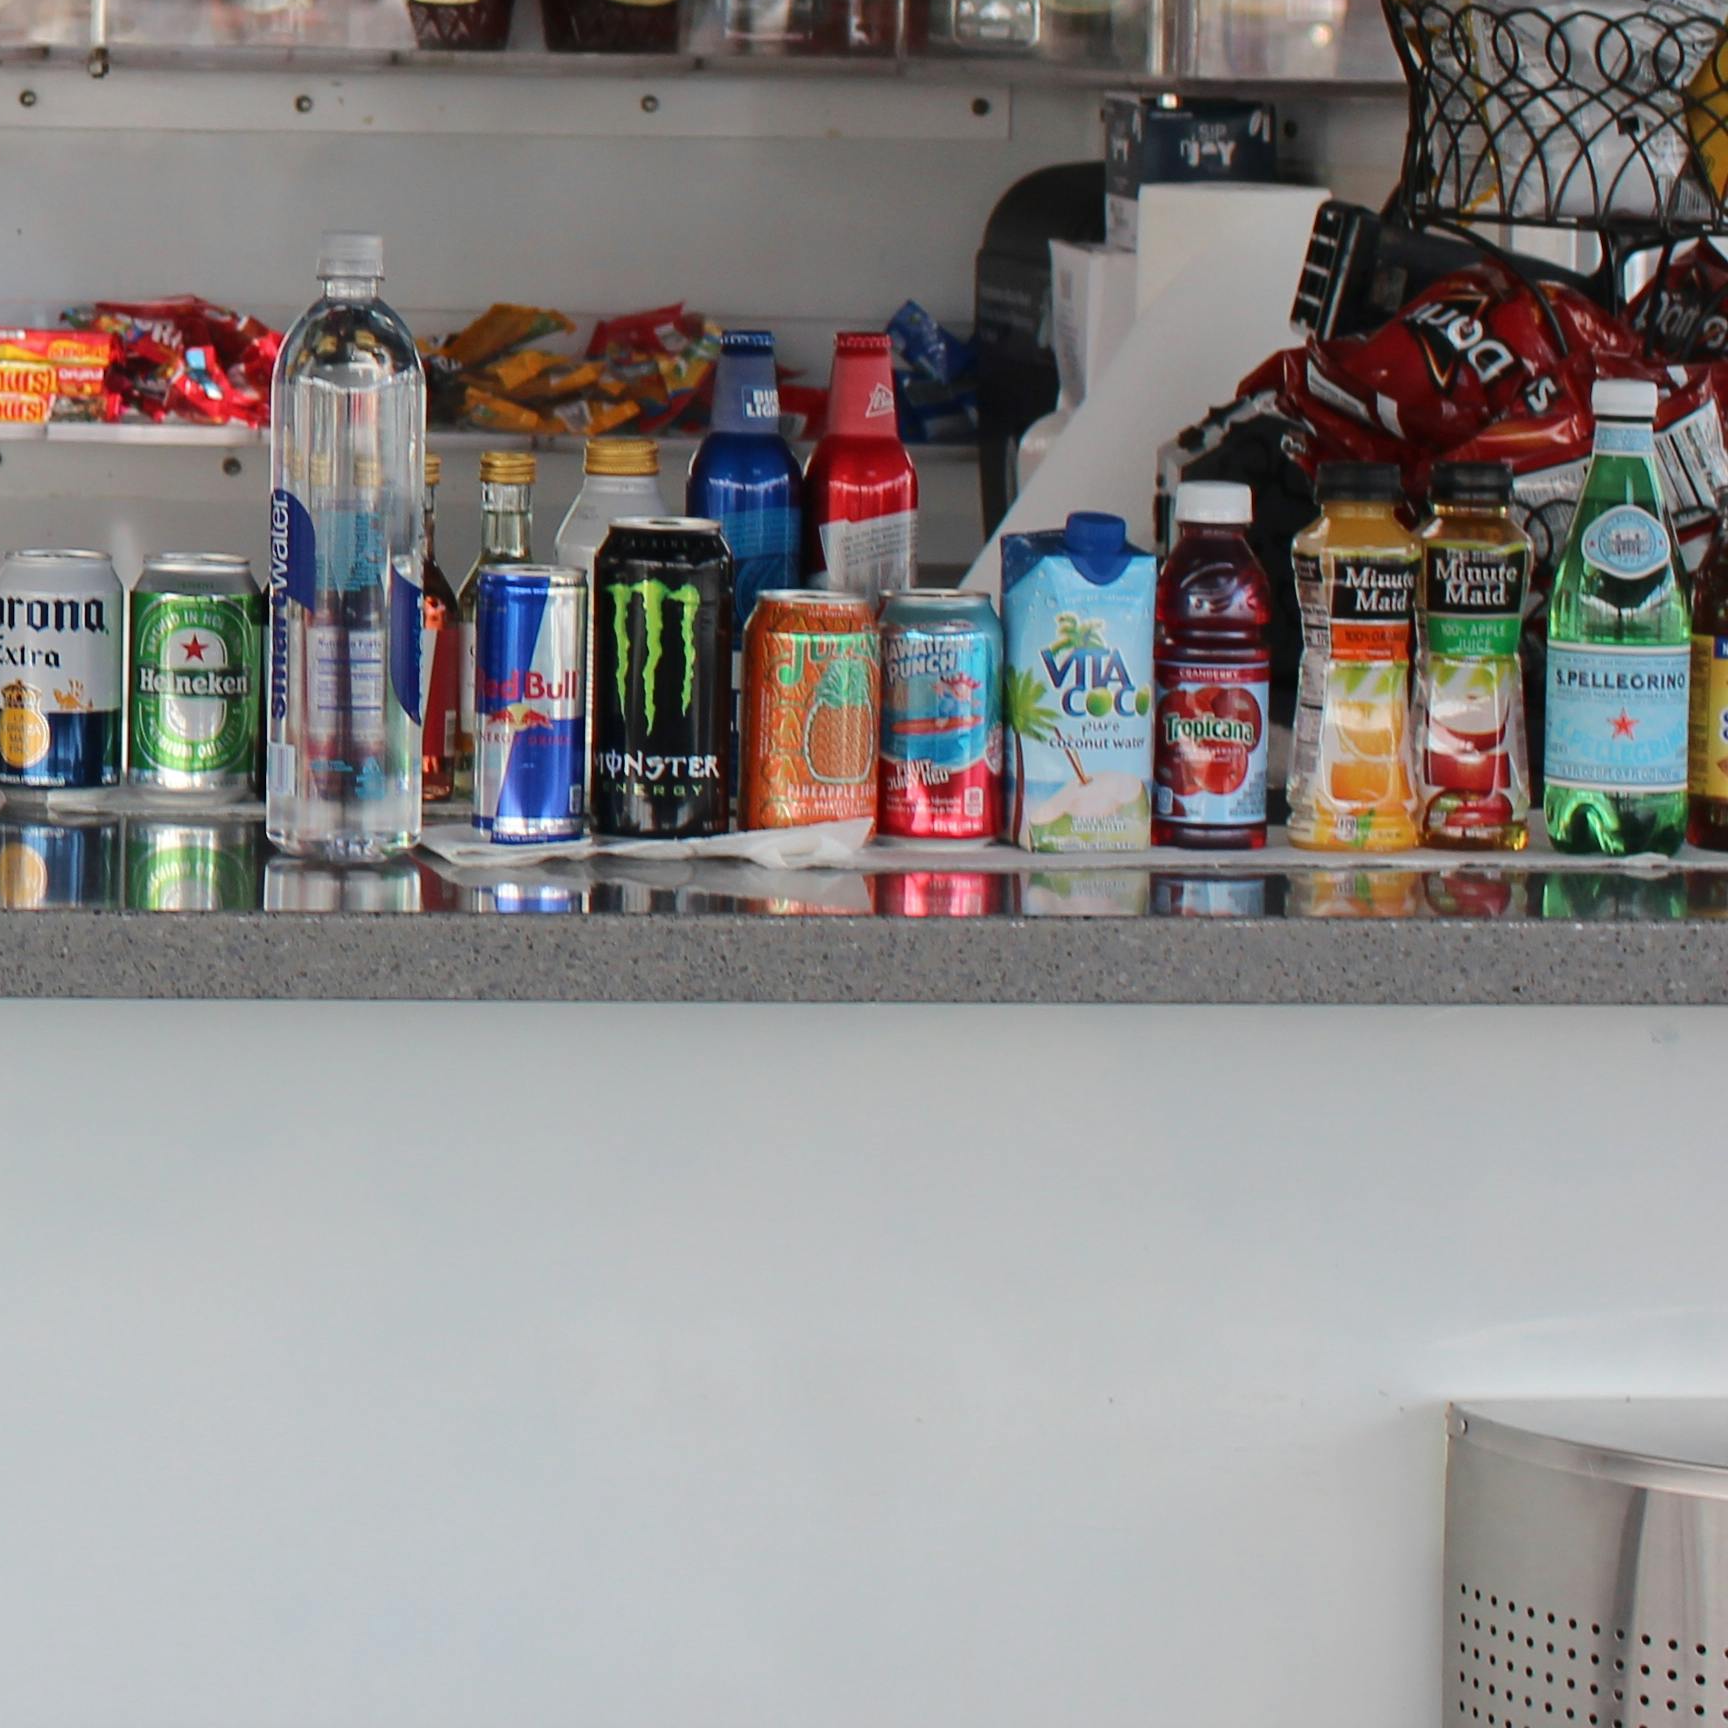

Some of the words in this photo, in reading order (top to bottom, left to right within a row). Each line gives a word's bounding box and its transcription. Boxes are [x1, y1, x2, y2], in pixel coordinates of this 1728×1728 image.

[1345, 565, 1415, 589] Minute
[1435, 558, 1518, 582] Minute
[1355, 589, 1407, 613] Maid
[1444, 580, 1506, 606] Maid
[1469, 625, 1506, 638] APPLE
[1455, 638, 1493, 651] JUICE
[888, 650, 957, 684] PUNCH
[1039, 646, 1135, 691] VITA
[1179, 668, 1239, 681] CRANBERRY
[139, 667, 248, 697] Heineken
[525, 670, 579, 701] Bull
[1555, 668, 1687, 691] S.PELLEGRINO
[1061, 685, 1151, 718] COCO
[1081, 722, 1120, 738] pure
[1166, 713, 1255, 744] Tropicana
[1048, 735, 1108, 750] coconut
[787, 784, 855, 799] PINEAPPLE
